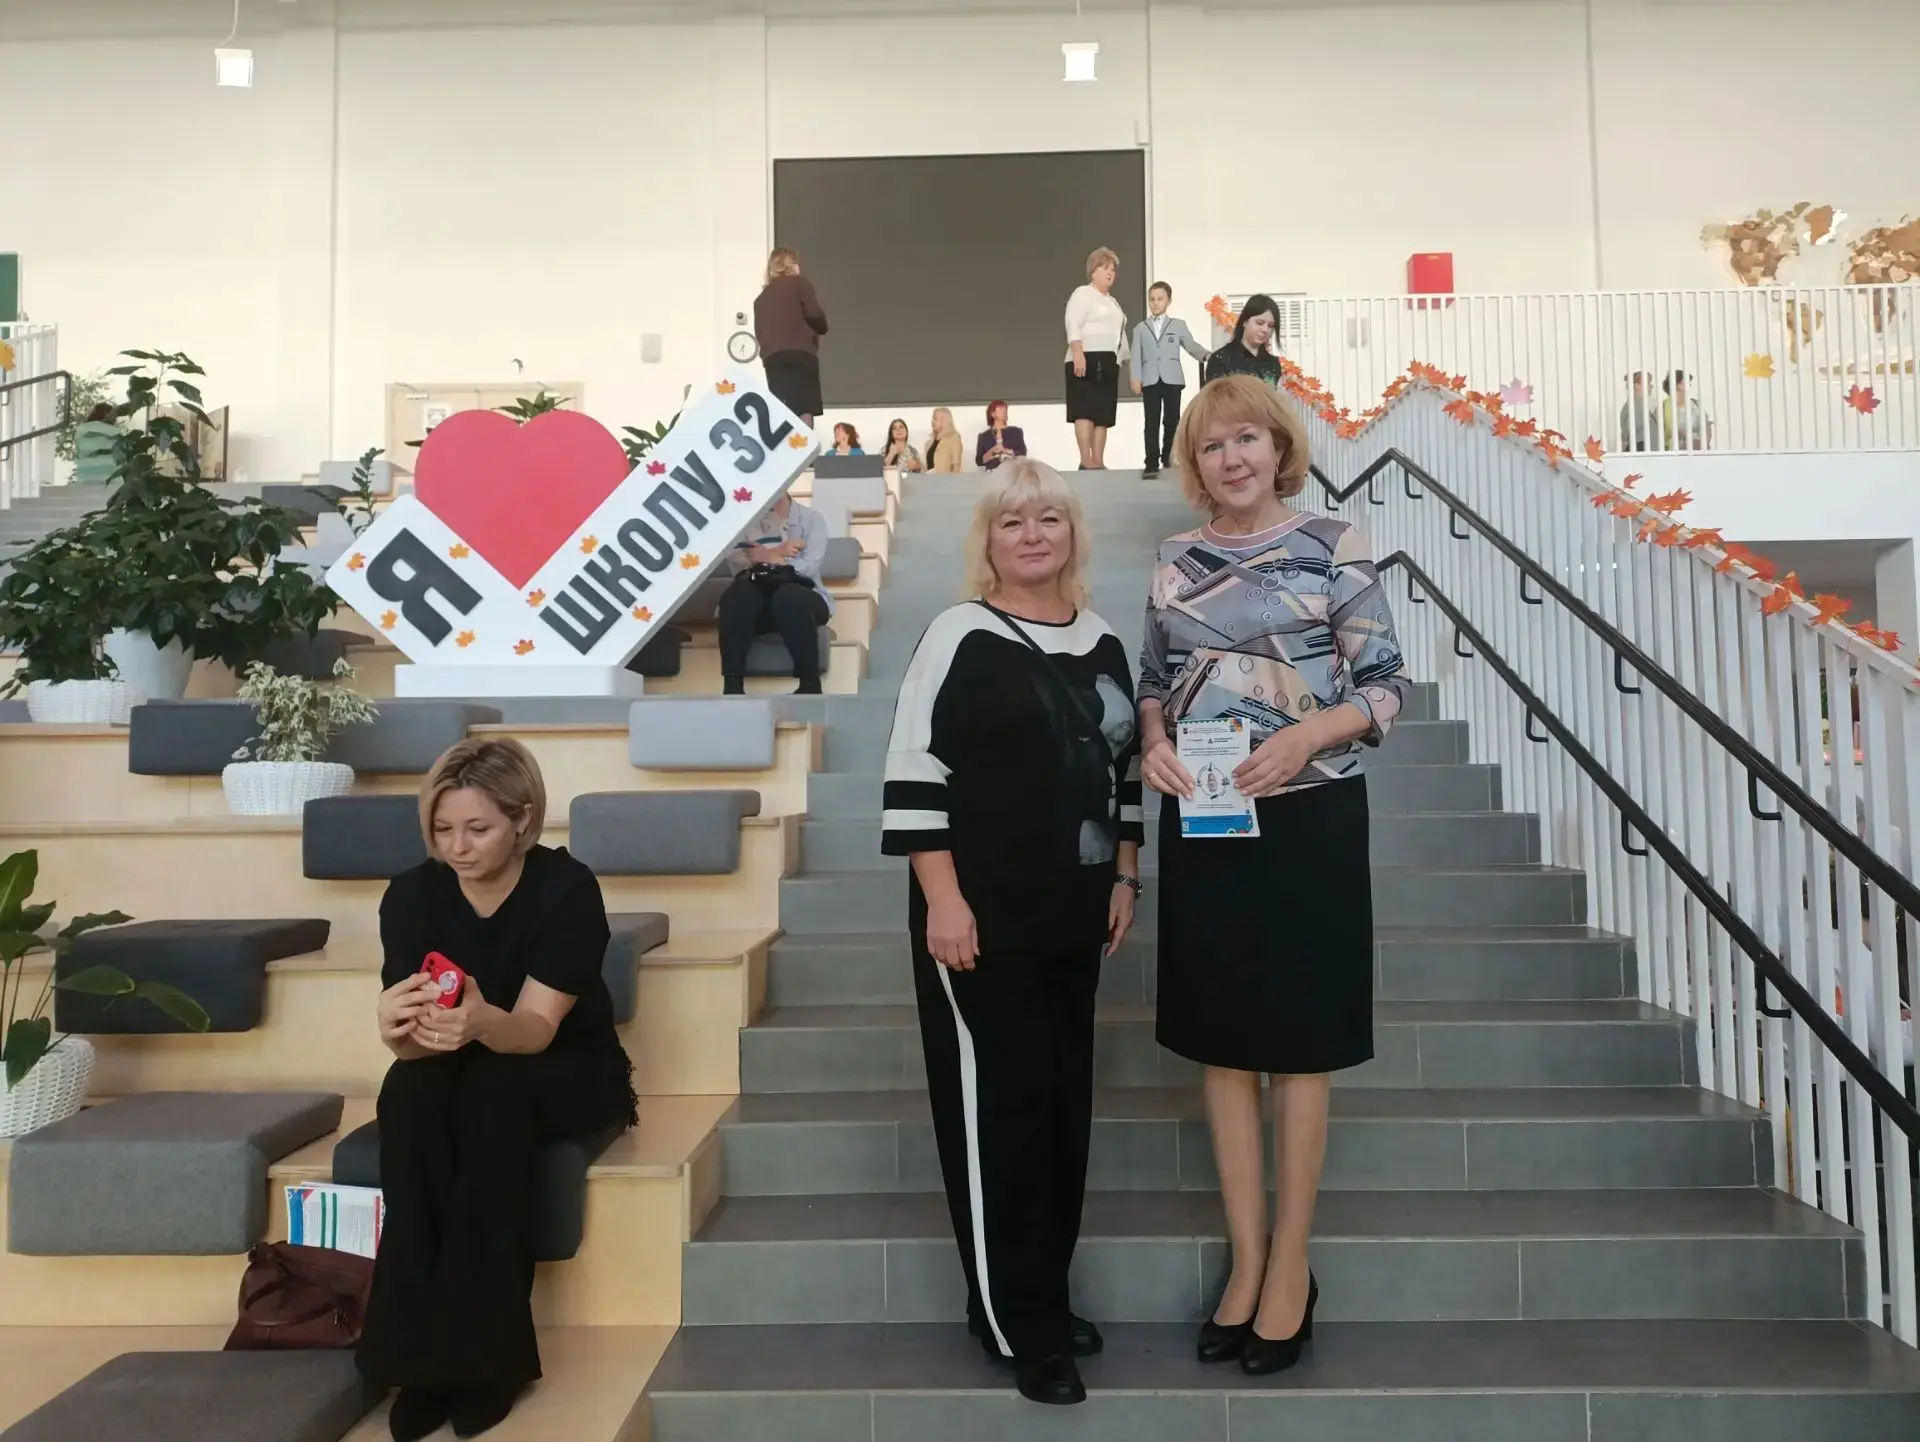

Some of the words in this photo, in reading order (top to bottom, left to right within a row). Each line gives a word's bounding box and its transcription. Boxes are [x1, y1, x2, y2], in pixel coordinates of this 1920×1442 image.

[366, 527, 483, 647] Я
[538, 450, 726, 656] ШКОЛУ
[708, 391, 794, 475] 32
